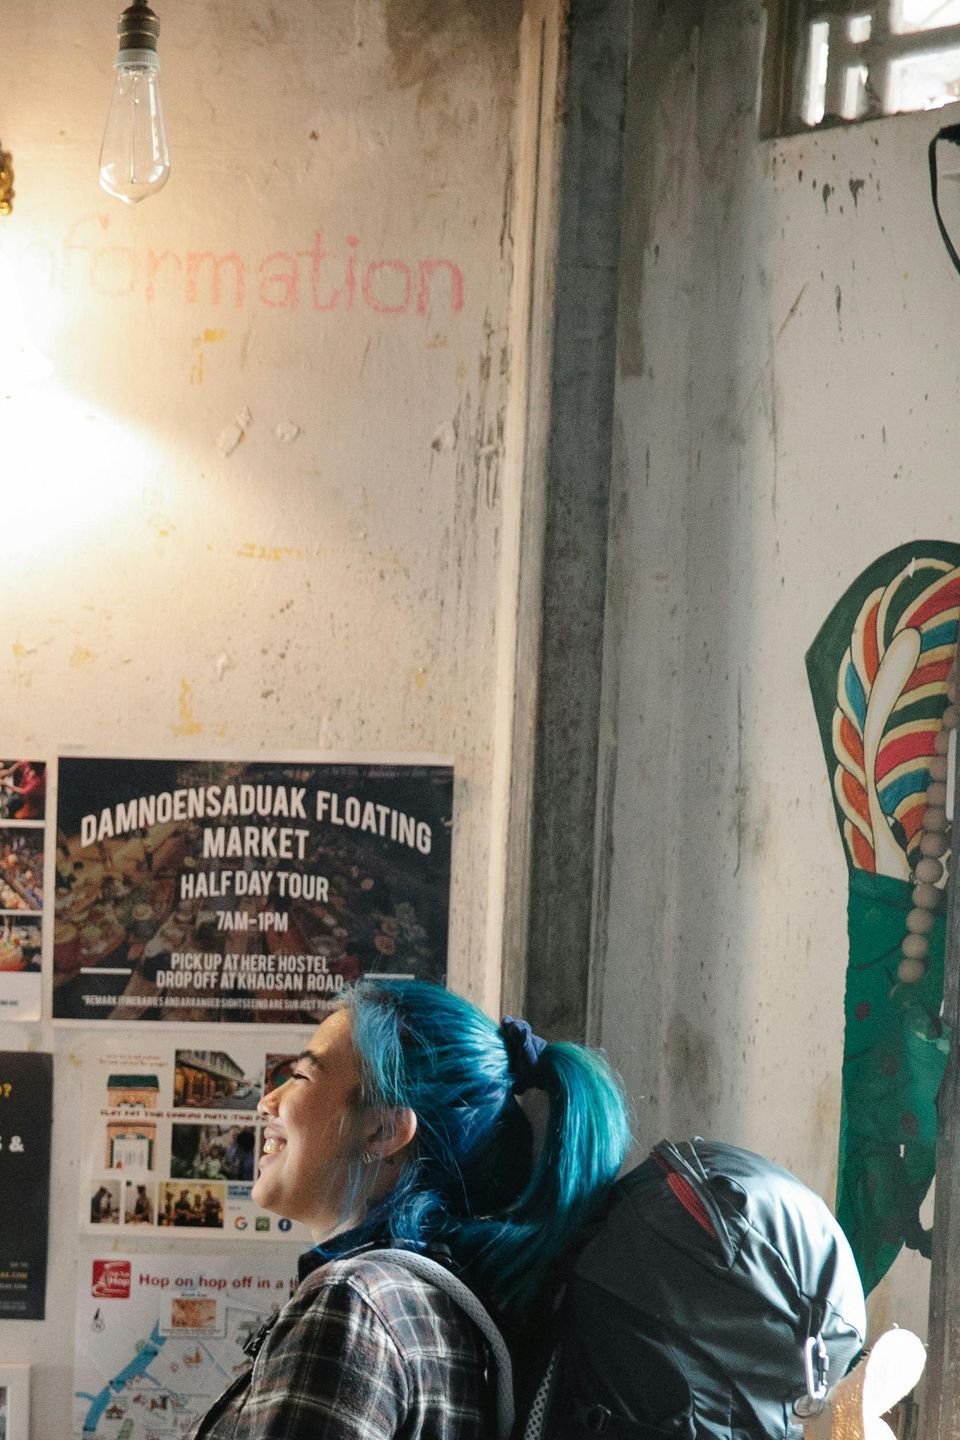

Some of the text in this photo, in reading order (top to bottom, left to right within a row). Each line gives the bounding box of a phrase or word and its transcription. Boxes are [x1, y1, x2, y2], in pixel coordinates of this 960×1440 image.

[80, 784, 432, 855] DAMNOENSADUAK FLOATING
[202, 826, 309, 860] MARKET
[180, 870, 329, 903] HALF DAY TOUR
[216, 910, 289, 932] 7AM-1PM
[170, 953, 329, 974] PICK UP AT HERE HOSTEL
[155, 972, 344, 992] DROP OFF AT KHAOSAN ROAD
[9, 1135, 25, 1153] &
[139, 1273, 170, 1290] Hop
[175, 1277, 194, 1288] on
[199, 1274, 227, 1290] hop
[232, 1276, 252, 1289] off
[257, 1278, 271, 1289] in
[275, 1281, 284, 1289] a
